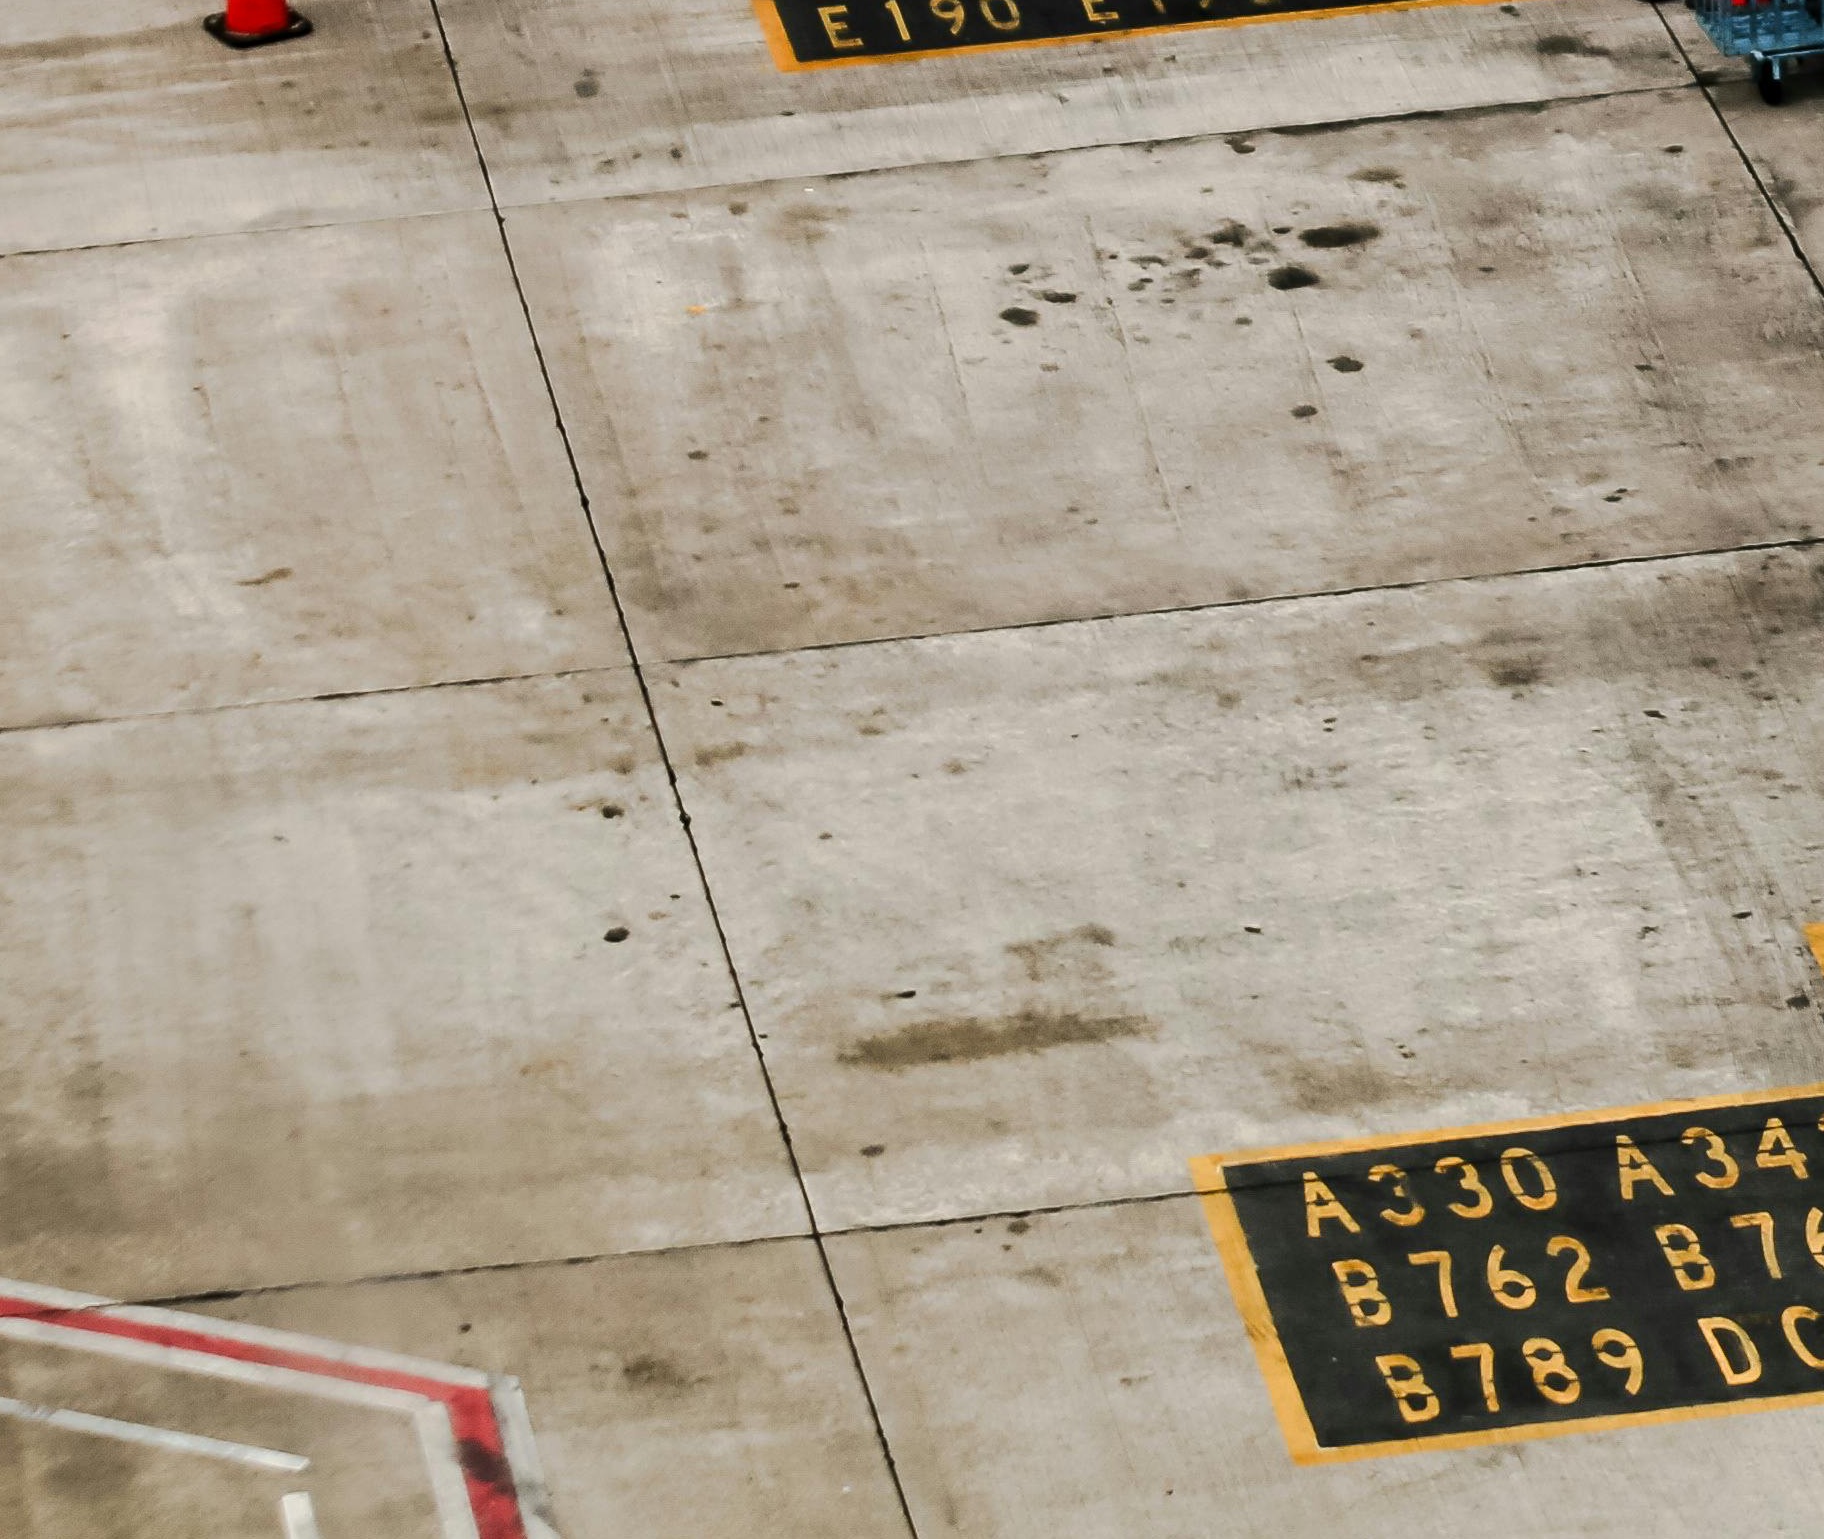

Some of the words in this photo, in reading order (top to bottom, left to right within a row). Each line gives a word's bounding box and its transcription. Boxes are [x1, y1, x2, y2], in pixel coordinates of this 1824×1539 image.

[1302, 1147, 1558, 1239] A330
[1331, 1234, 1611, 1328] B762
[1375, 1328, 1645, 1424] B789
